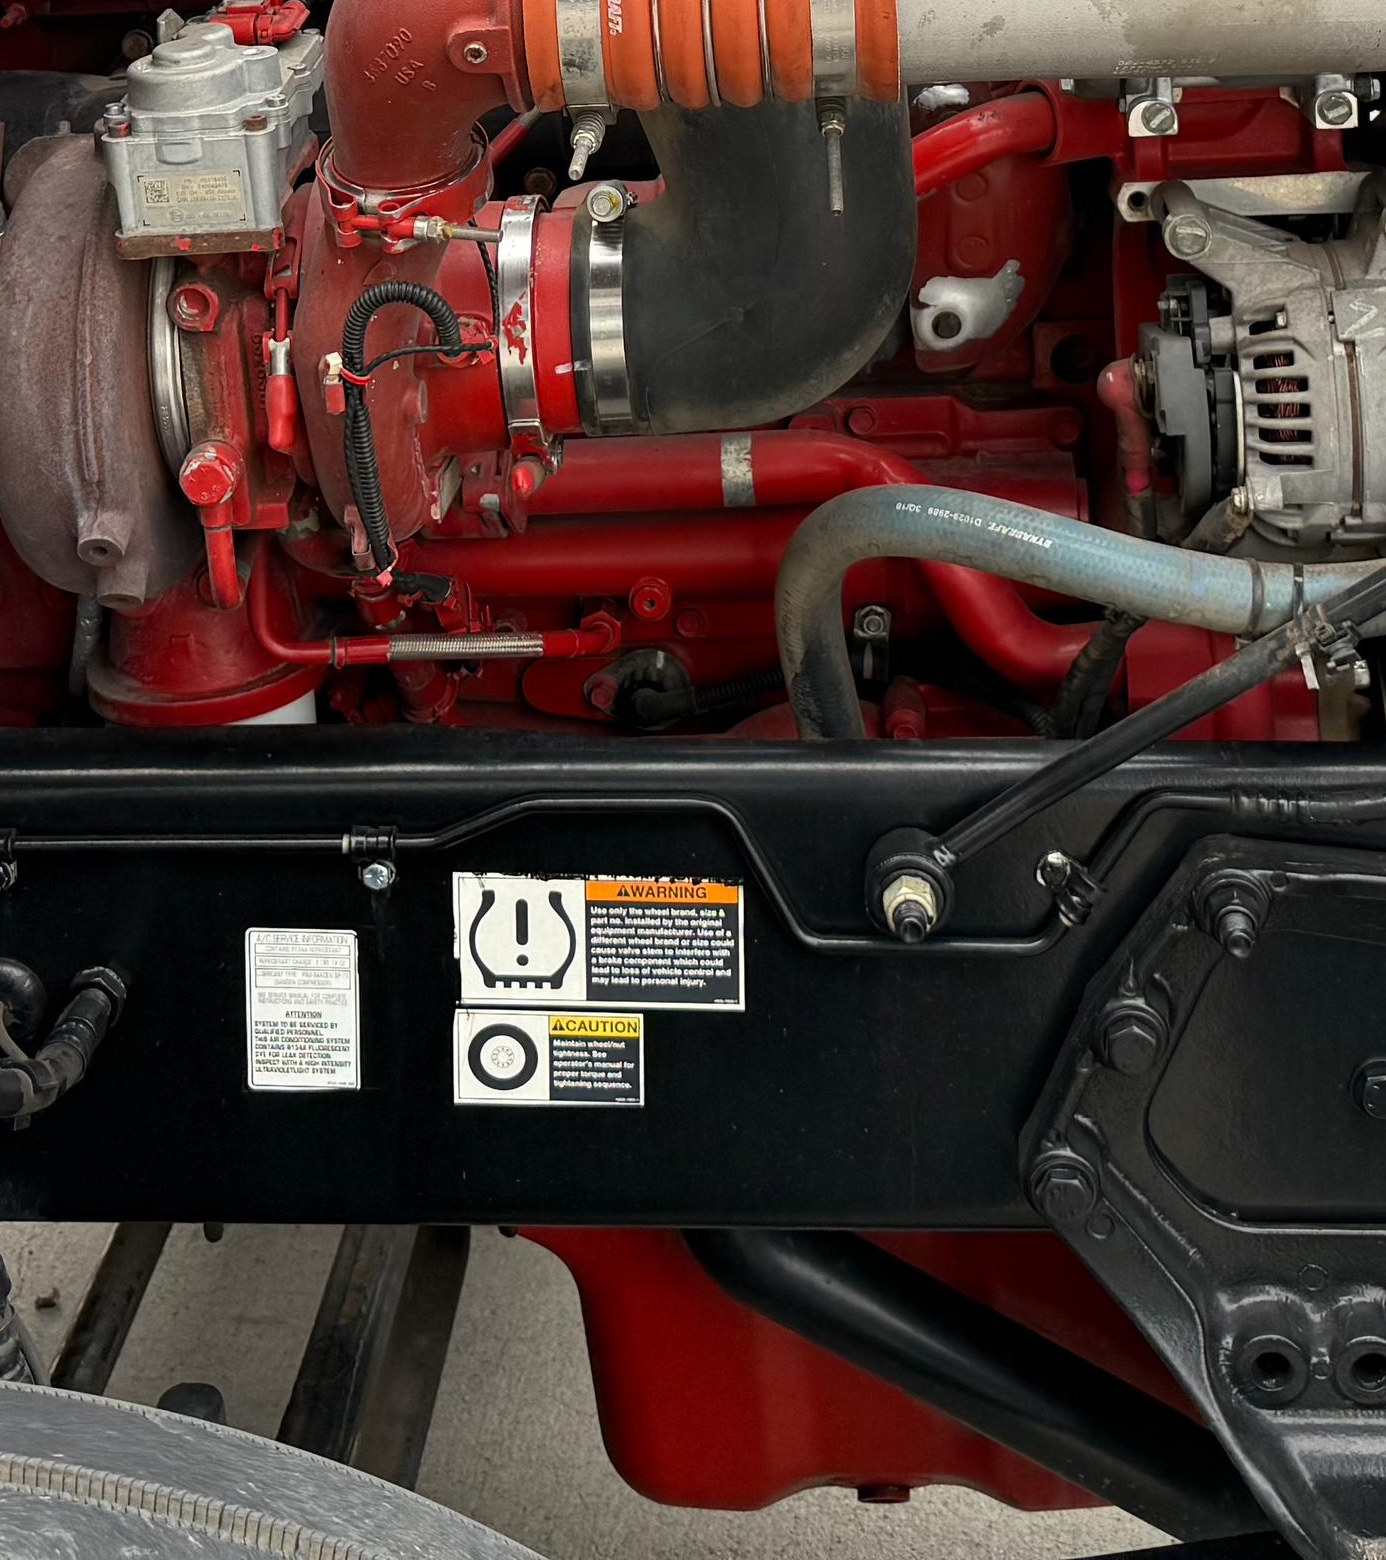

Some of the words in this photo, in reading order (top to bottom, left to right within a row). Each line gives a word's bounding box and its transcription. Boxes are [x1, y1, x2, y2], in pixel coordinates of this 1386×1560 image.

[630, 886, 707, 898] WARNING
[609, 907, 627, 916] only
[629, 907, 642, 915] the
[671, 908, 697, 917] brand,
[591, 917, 607, 925] part
[625, 917, 660, 925] installed
[663, 918, 673, 926] by
[691, 919, 722, 927] original
[591, 927, 635, 936] equipment
[637, 928, 695, 936] manufacturer.
[697, 928, 713, 936] Use
[642, 947, 663, 955] stem
[675, 948, 711, 956] interfere
[712, 948, 730, 956] with
[624, 957, 671, 966] component
[652, 967, 682, 975] vehicle
[684, 968, 713, 976] control
[642, 977, 678, 986] personal
[680, 978, 706, 986] injury.
[285, 1011, 322, 1019] ATTENTION
[566, 1020, 638, 1033] CAUTION
